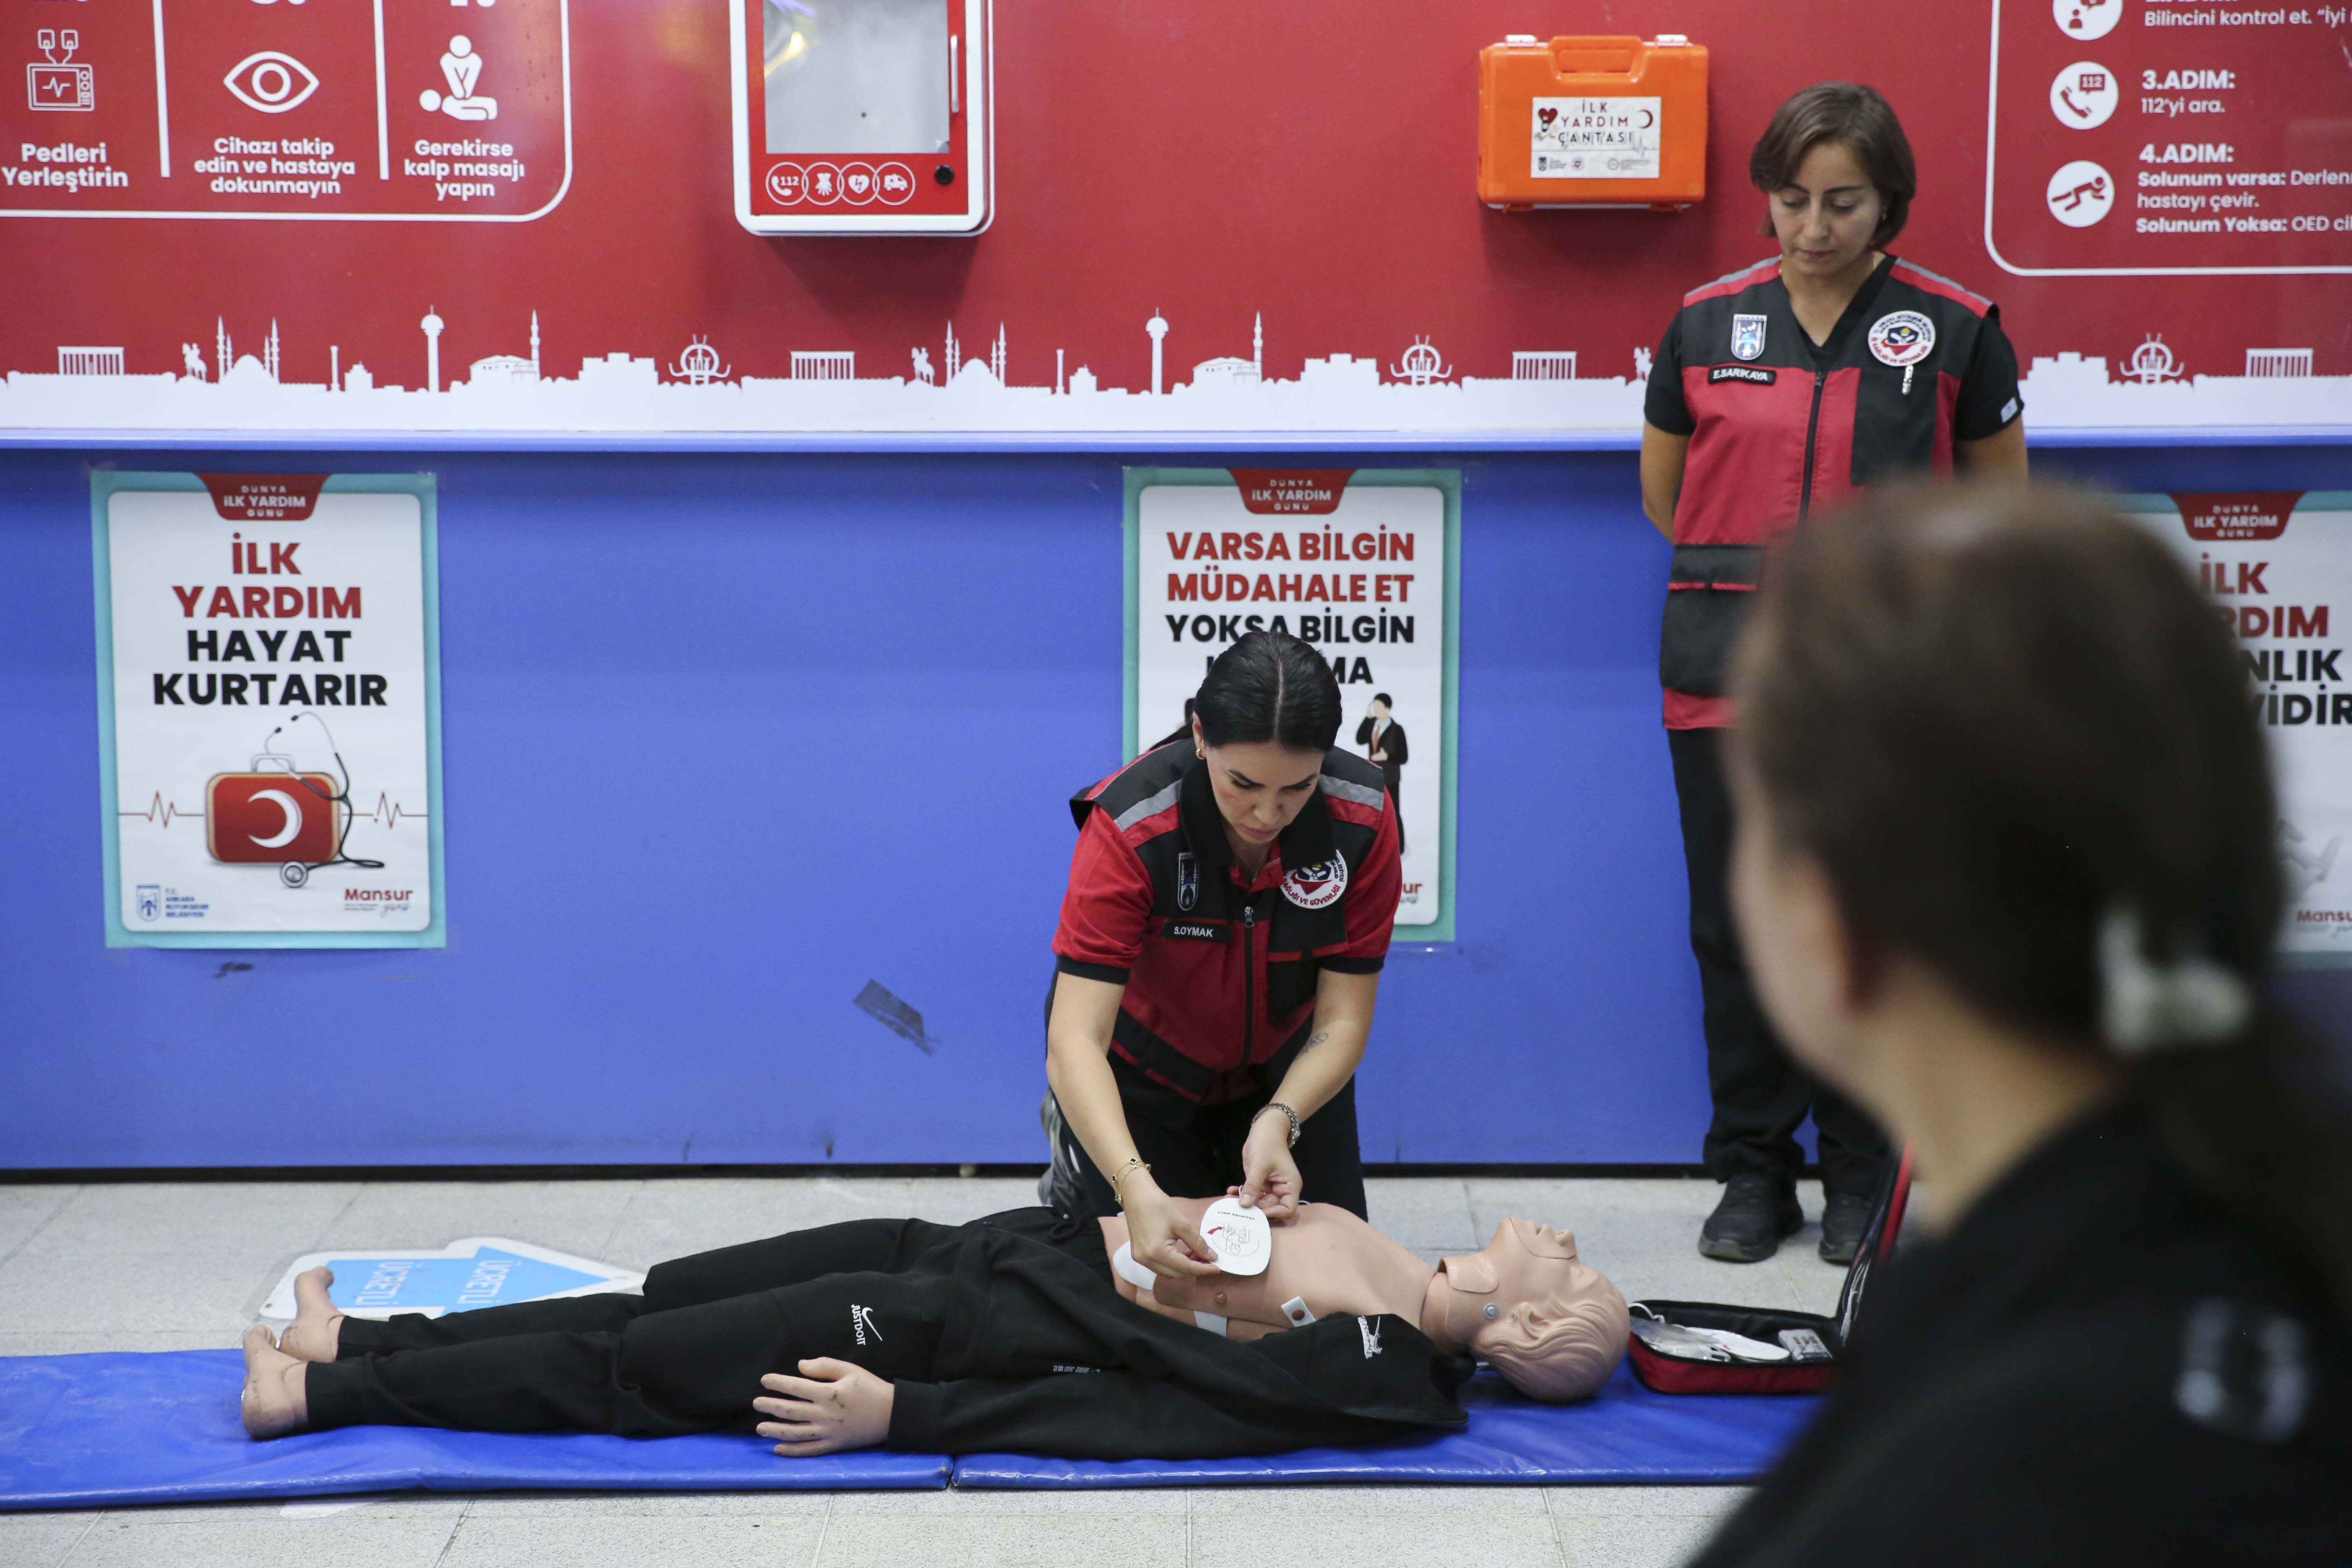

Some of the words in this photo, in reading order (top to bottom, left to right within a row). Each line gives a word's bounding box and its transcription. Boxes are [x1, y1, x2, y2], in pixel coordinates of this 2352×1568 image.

[2145, 9, 2216, 26] Bilincini
[2220, 8, 2285, 25] kontrol
[2289, 9, 2312, 24] et.
[2082, 75, 2103, 88] 112
[2142, 69, 2236, 90] 3.ADIM:
[1582, 99, 1608, 113] İLK
[2188, 99, 2226, 114] ara.
[1561, 116, 1628, 127] YARDIM
[214, 136, 278, 154] Cihazı
[281, 137, 335, 160] takip
[414, 138, 514, 157] Gerekirse
[1558, 131, 1633, 146] ÇANTASI
[21, 141, 107, 163] Pedleri
[2138, 143, 2235, 164] 4.ADIM:
[194, 156, 240, 174] edin
[242, 160, 268, 174] ve
[271, 157, 356, 180] hastaya
[404, 158, 450, 181] kalp
[453, 159, 526, 182] masajı
[2138, 170, 2223, 187] Solunum
[2225, 172, 2287, 186] varsa:
[2290, 168, 2352, 186] Derlen
[1, 165, 129, 193] Yerleştirin
[210, 176, 342, 199] dokunmayın
[780, 176, 800, 186] 112
[435, 182, 495, 202] yapın
[2136, 192, 2206, 213] hastayı
[2209, 191, 2260, 213] çevir.
[2136, 216, 2221, 233] Solunum
[2223, 215, 2288, 232] Yoksa:
[2291, 215, 2330, 232] OED
[2333, 214, 2352, 232] ci
[248, 495, 306, 508] YARDIM
[1276, 489, 1331, 501] YARDIM
[2219, 514, 2278, 528] YARDIM
[1167, 532, 1291, 561] VARSA
[1300, 524, 1414, 561] BİLGİN
[232, 532, 301, 574] İLK
[1167, 565, 1367, 602] MÜDAHALE
[1376, 575, 1414, 602] ET
[2200, 552, 2269, 595] İLK
[172, 586, 362, 619] YARDIM
[1300, 607, 1414, 643] BİLGİN
[187, 630, 352, 662] HAYAT
[153, 674, 388, 706] KURTARIR
[345, 889, 413, 901] Mansur
[1300, 897, 1308, 905] VE
[1174, 926, 1214, 938] S.OYMAK
